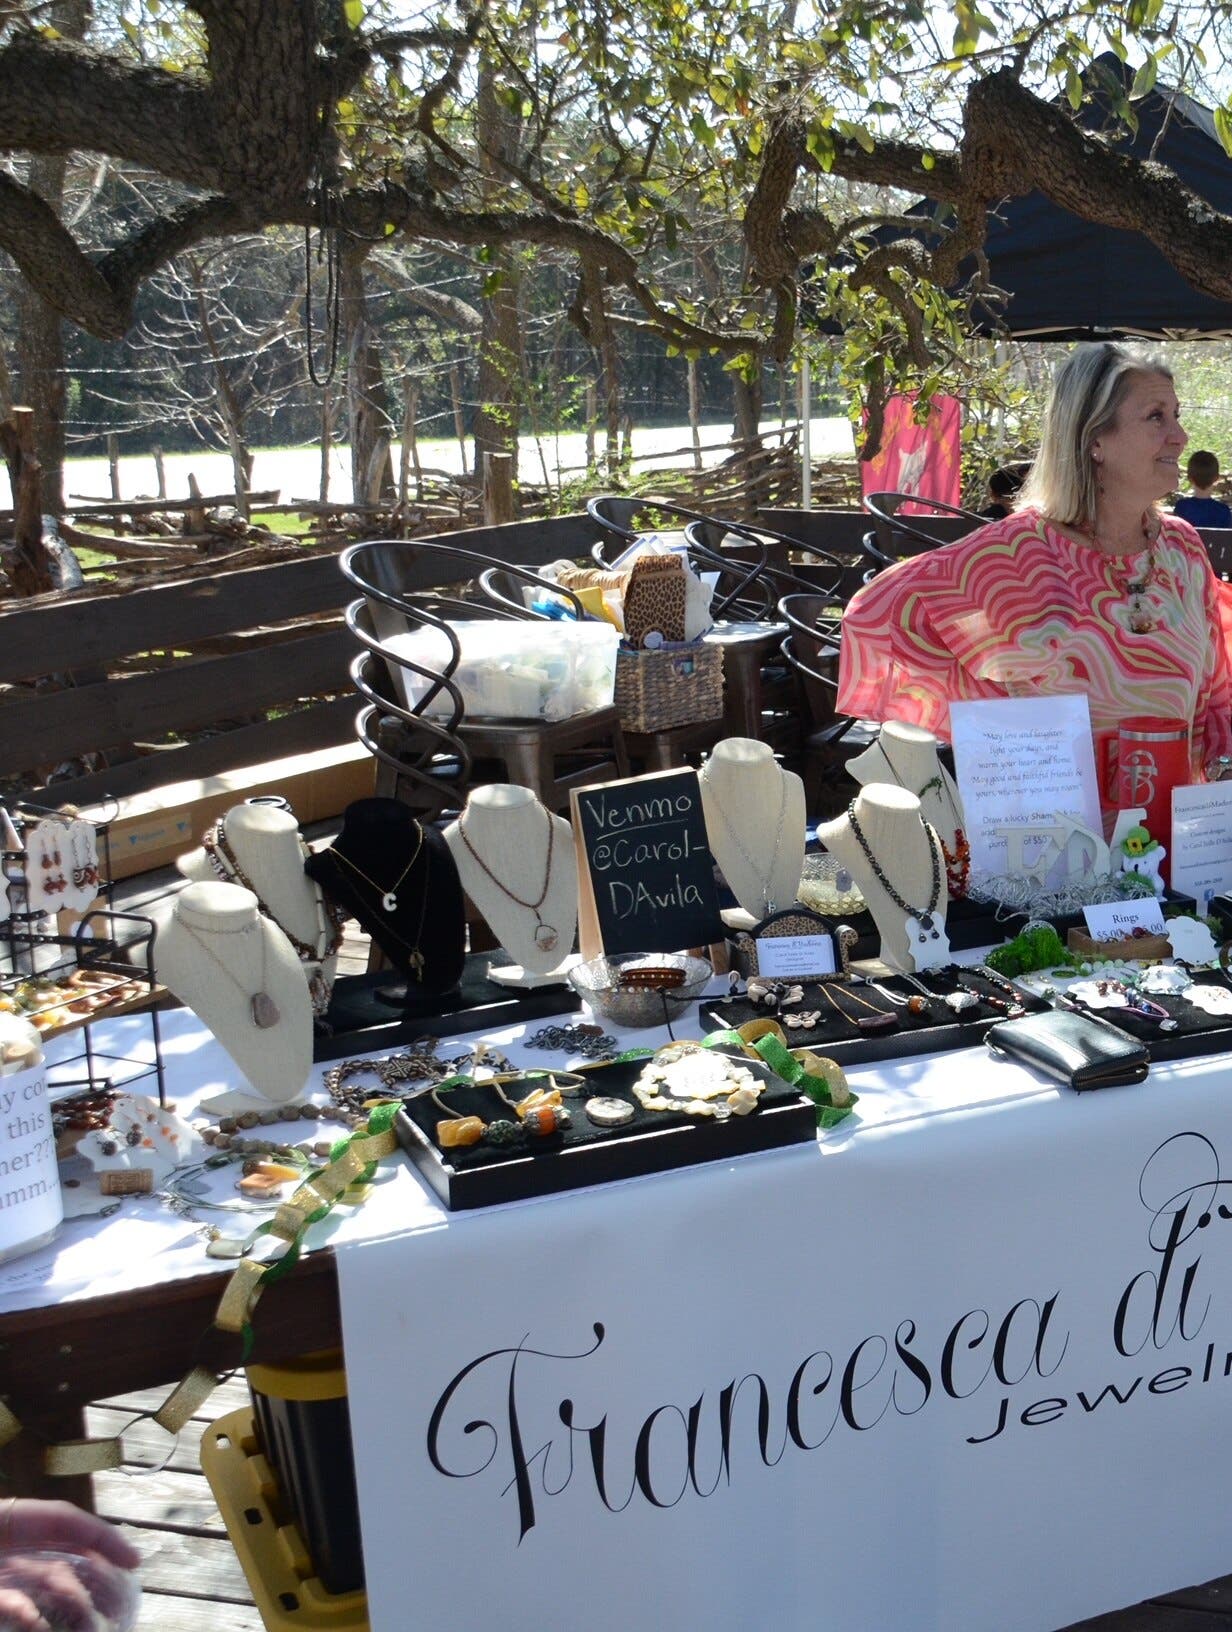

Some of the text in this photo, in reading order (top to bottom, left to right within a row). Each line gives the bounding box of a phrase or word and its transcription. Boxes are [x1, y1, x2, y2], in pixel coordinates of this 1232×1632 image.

[586, 793, 692, 828] Venmo
[592, 829, 706, 871] @Carol-
[608, 873, 705, 919] DAvila
[1112, 914, 1140, 924] Rings
[8, 1112, 45, 1139] this
[426, 1289, 1071, 1548] Francesca
